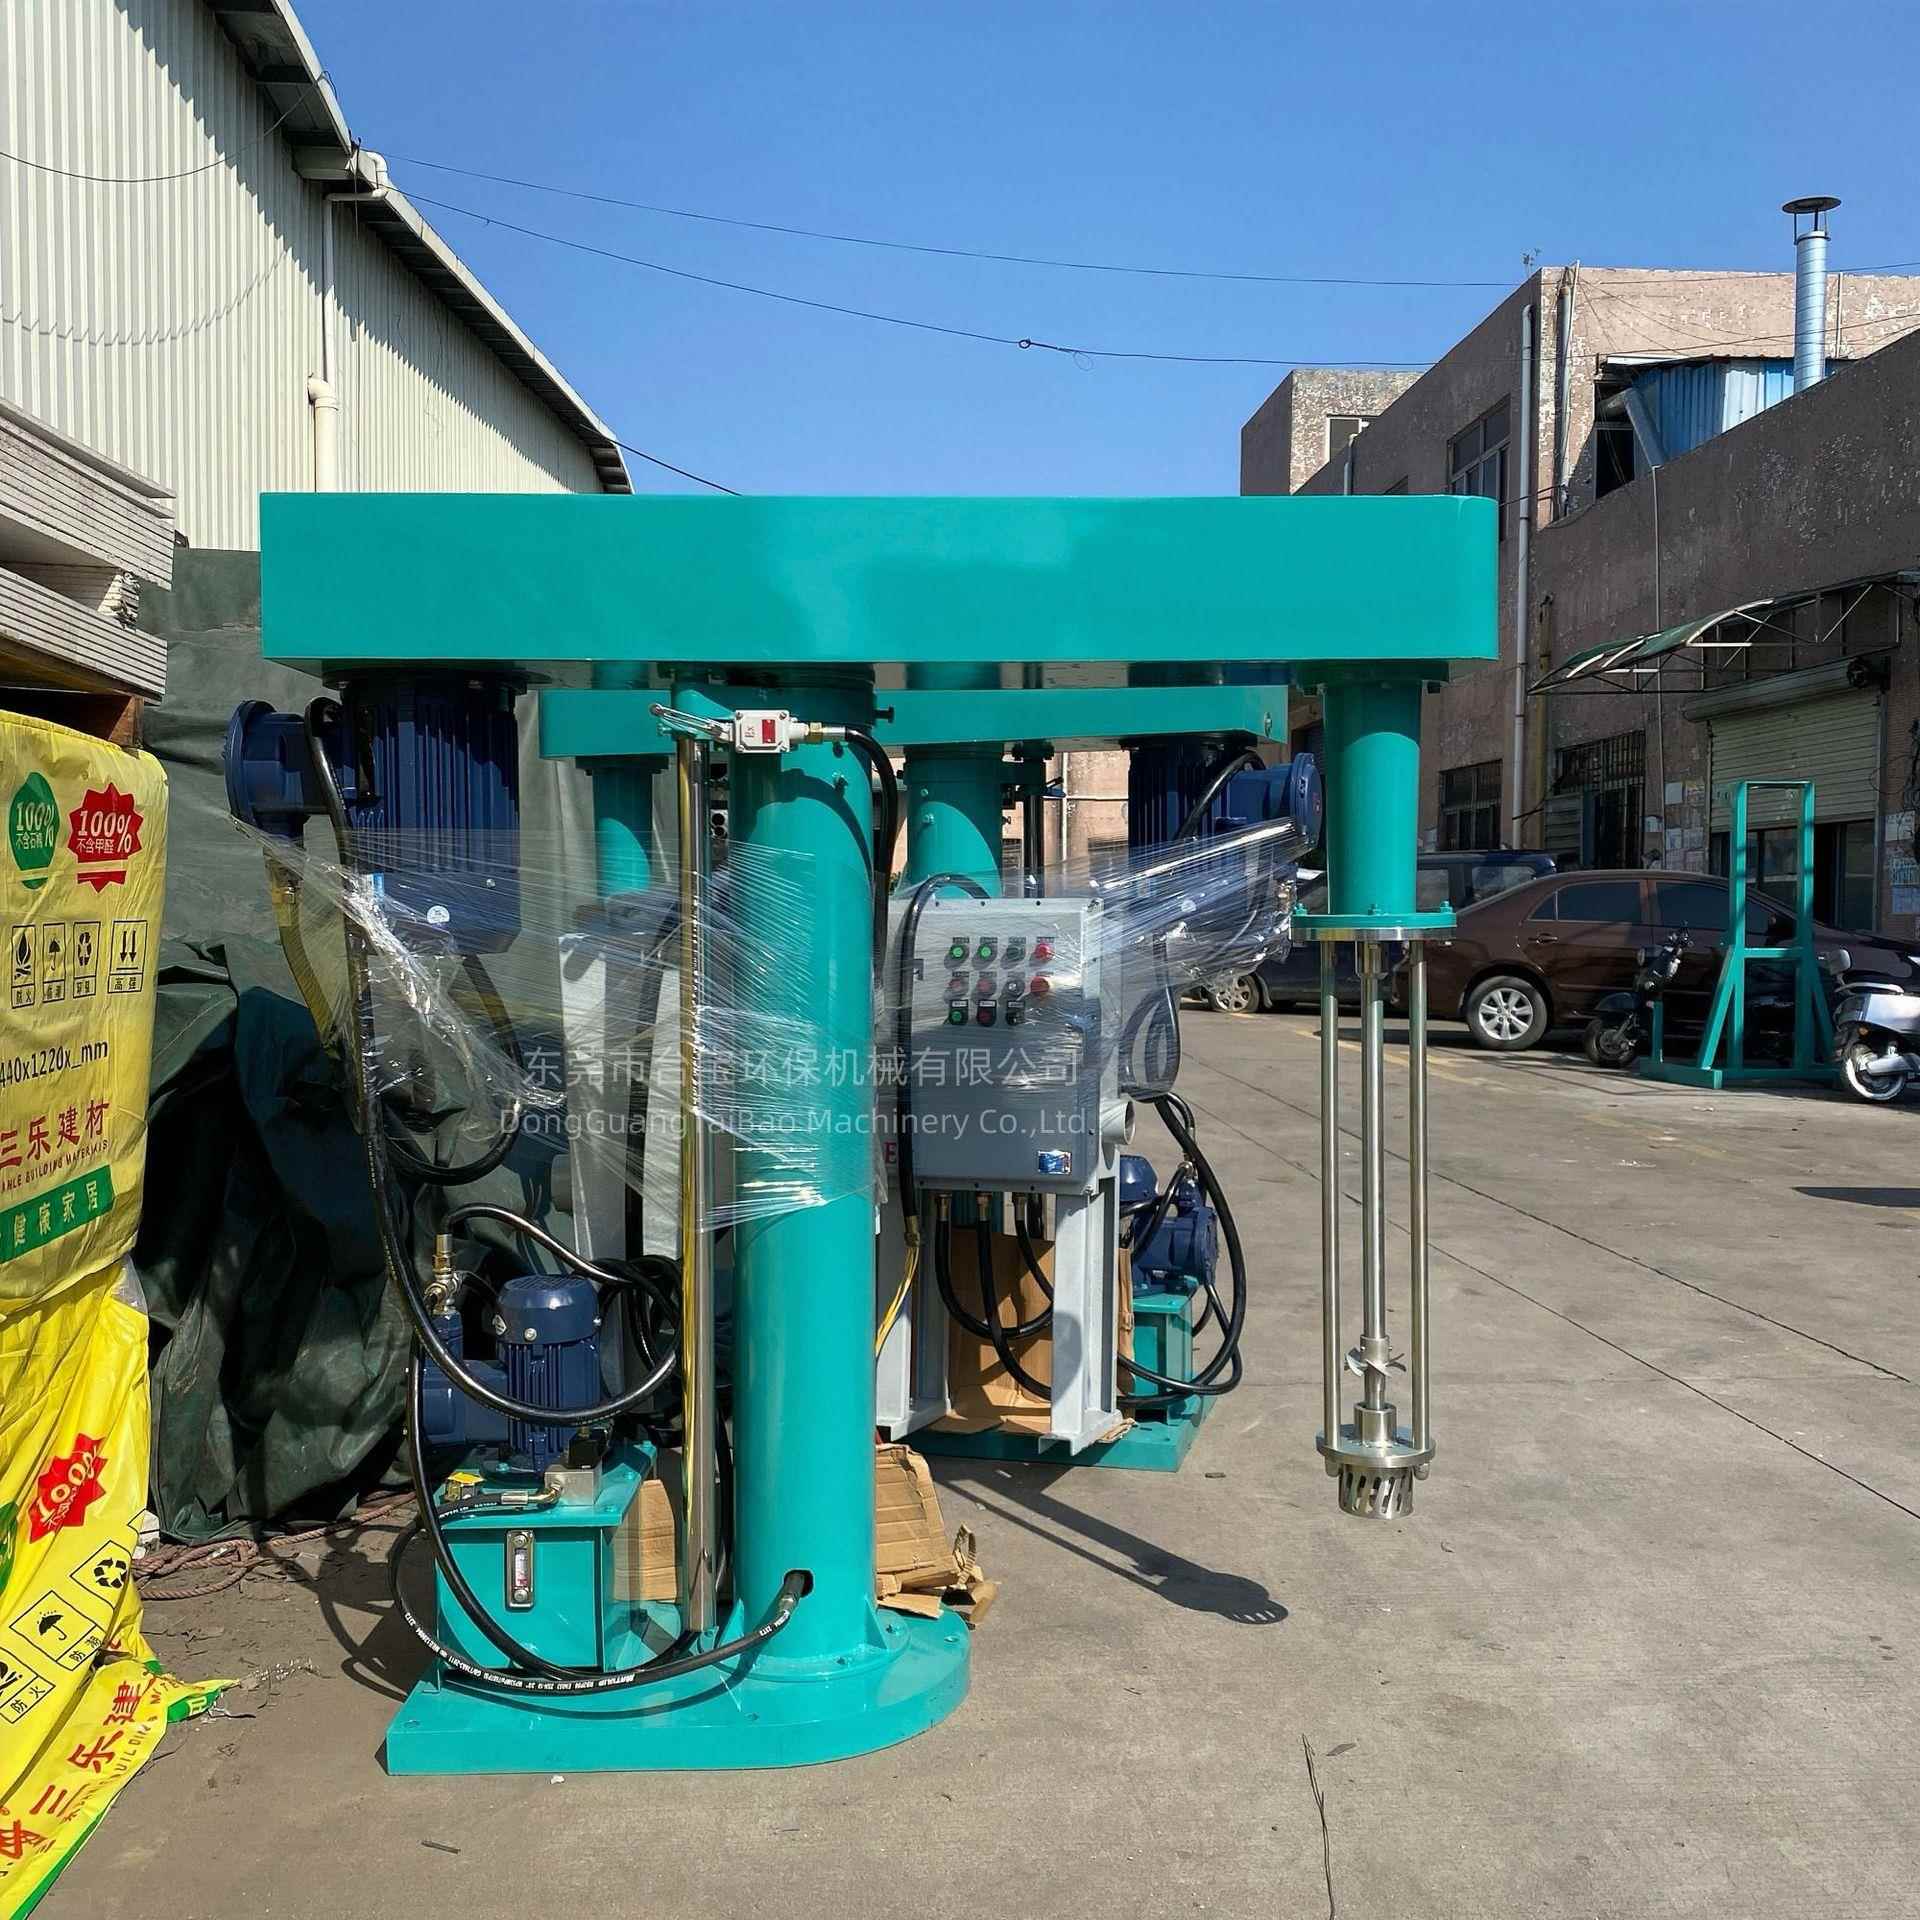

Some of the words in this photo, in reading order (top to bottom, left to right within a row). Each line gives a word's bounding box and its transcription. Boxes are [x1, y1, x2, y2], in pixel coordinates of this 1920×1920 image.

[16, 802, 55, 847] 100%
[76, 838, 115, 854] 不含甲醛
[78, 810, 132, 853] 100%
[0, 1096, 110, 1169] 三乐建材
[14, 1180, 98, 1247] 健康家居
[10, 1686, 46, 1714] 防火
[29, 1674, 165, 1818] 三乐建
